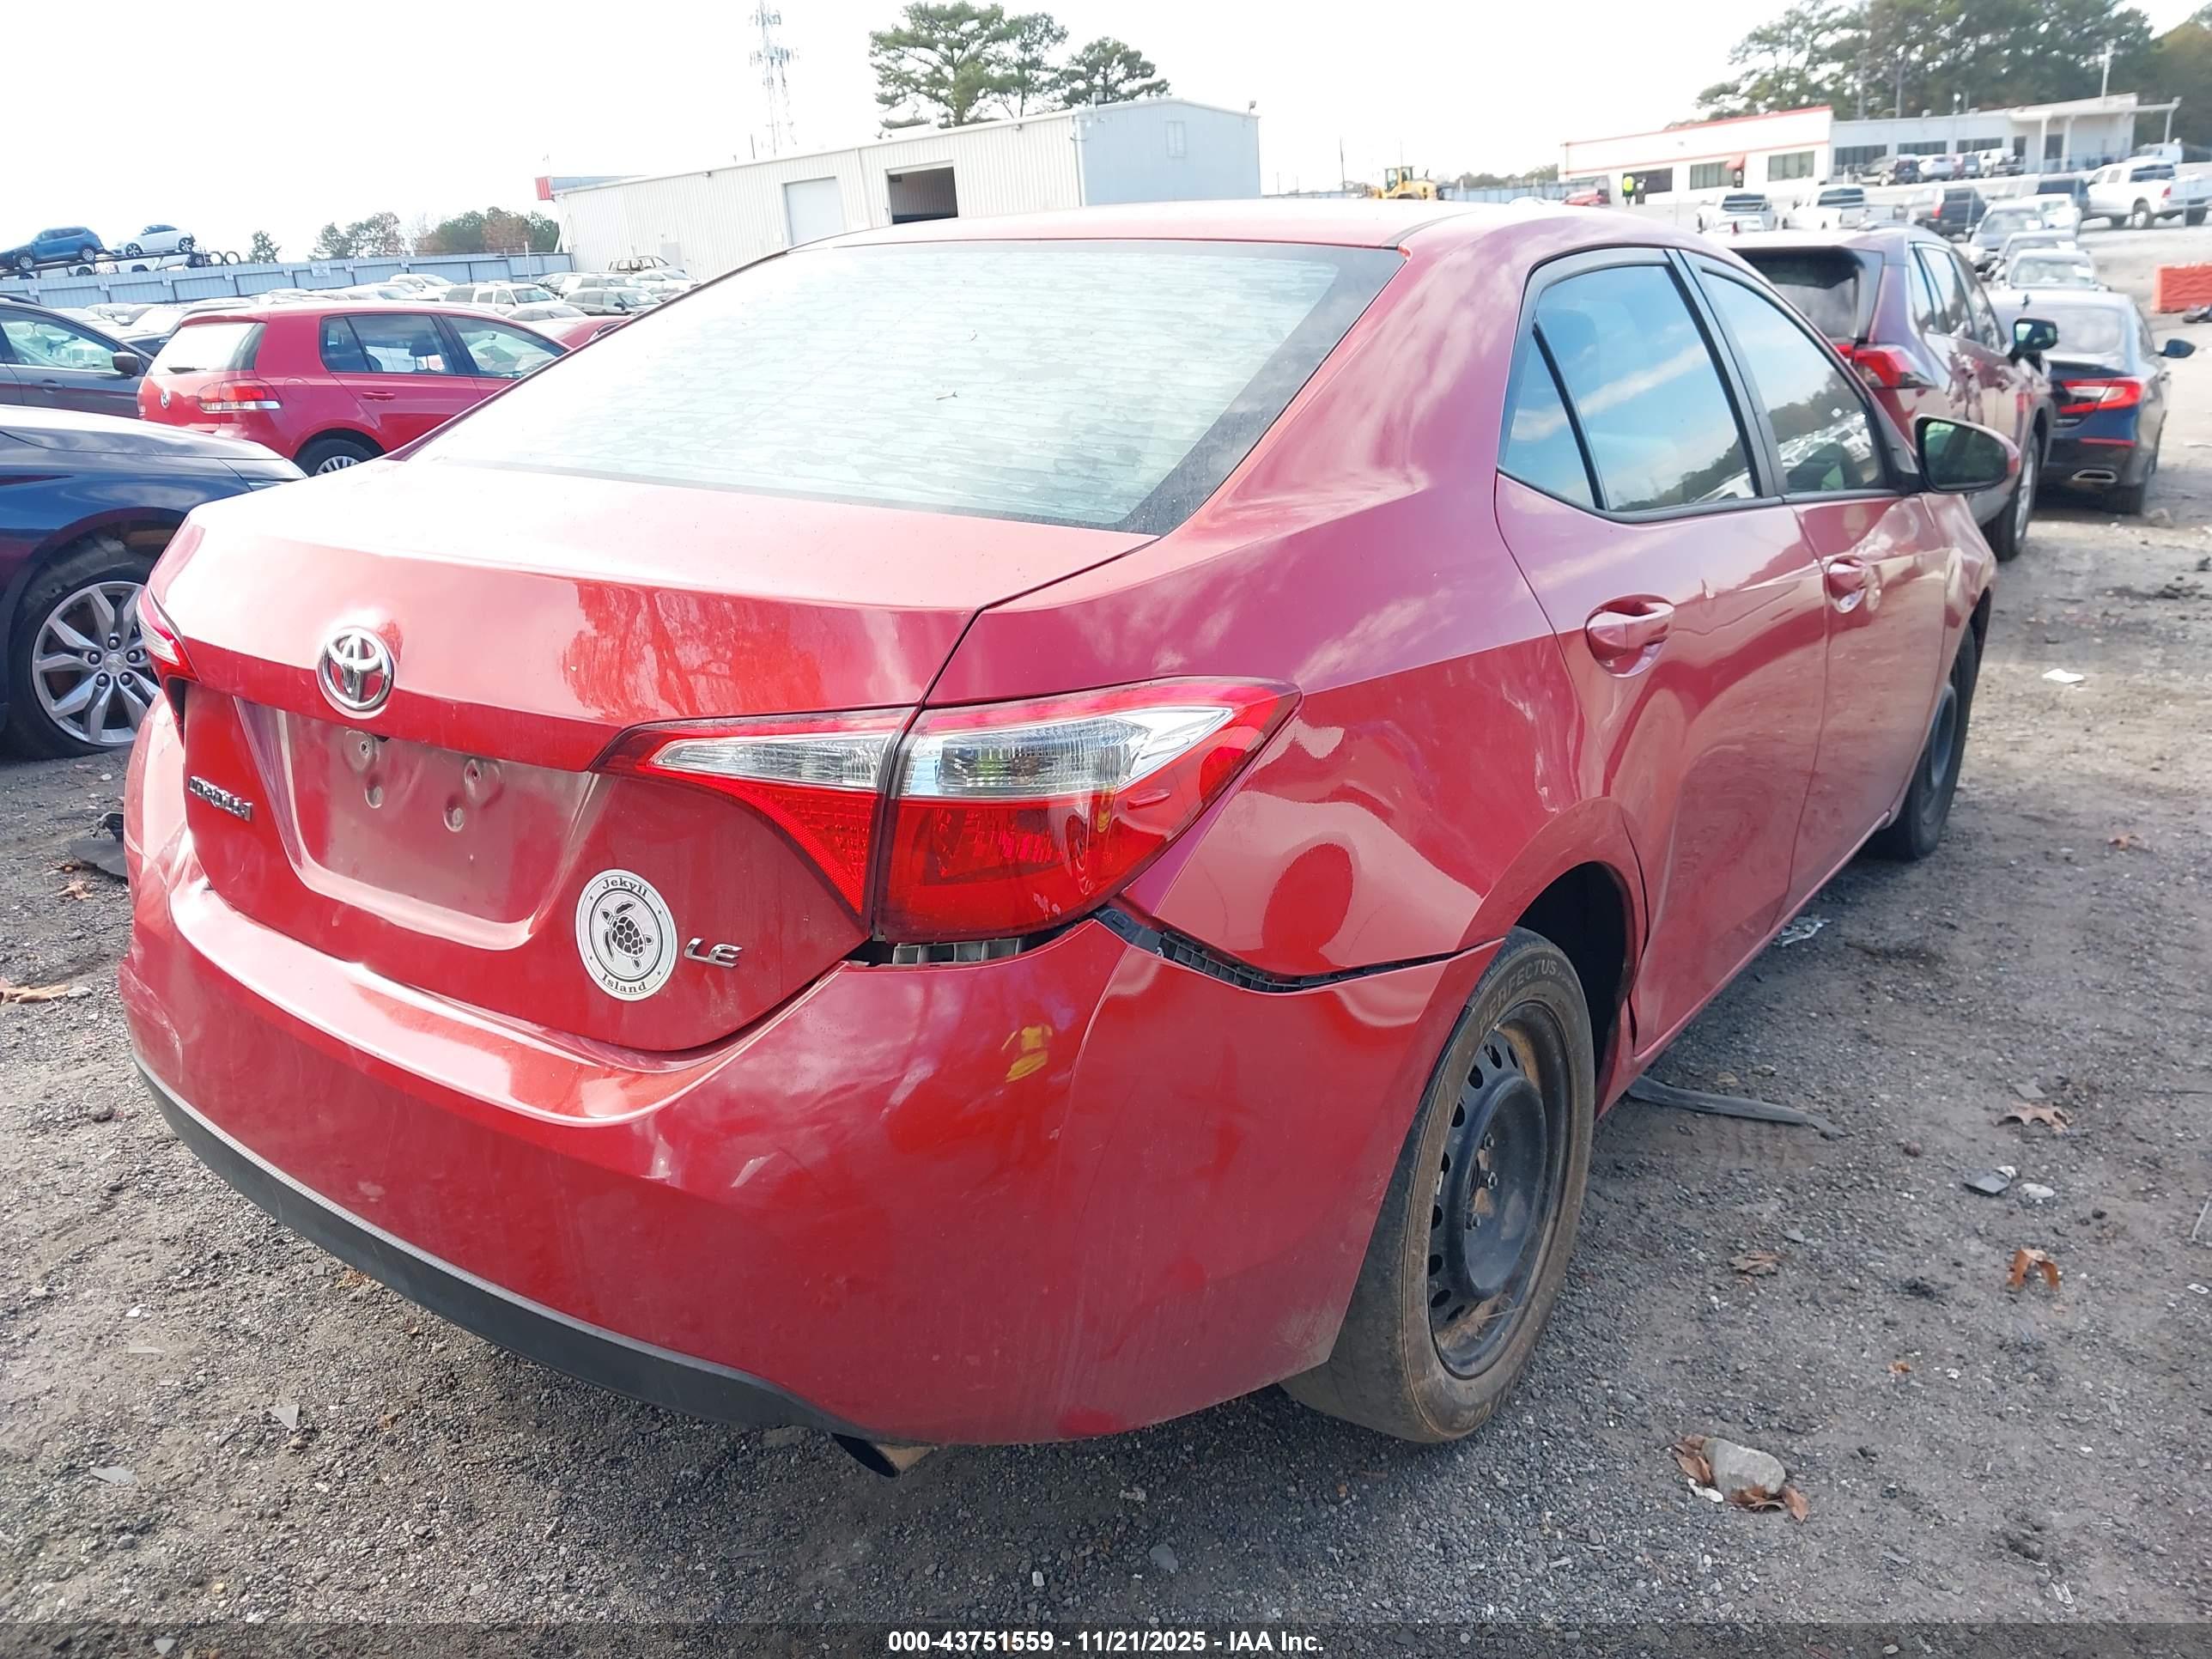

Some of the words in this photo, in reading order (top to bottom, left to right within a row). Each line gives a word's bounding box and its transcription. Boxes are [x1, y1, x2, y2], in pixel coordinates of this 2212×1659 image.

[601, 877, 647, 899] Jekyll
[684, 938, 744, 969] LE
[601, 973, 647, 994] Island
[1479, 959, 1558, 1037] PERFECTUS
